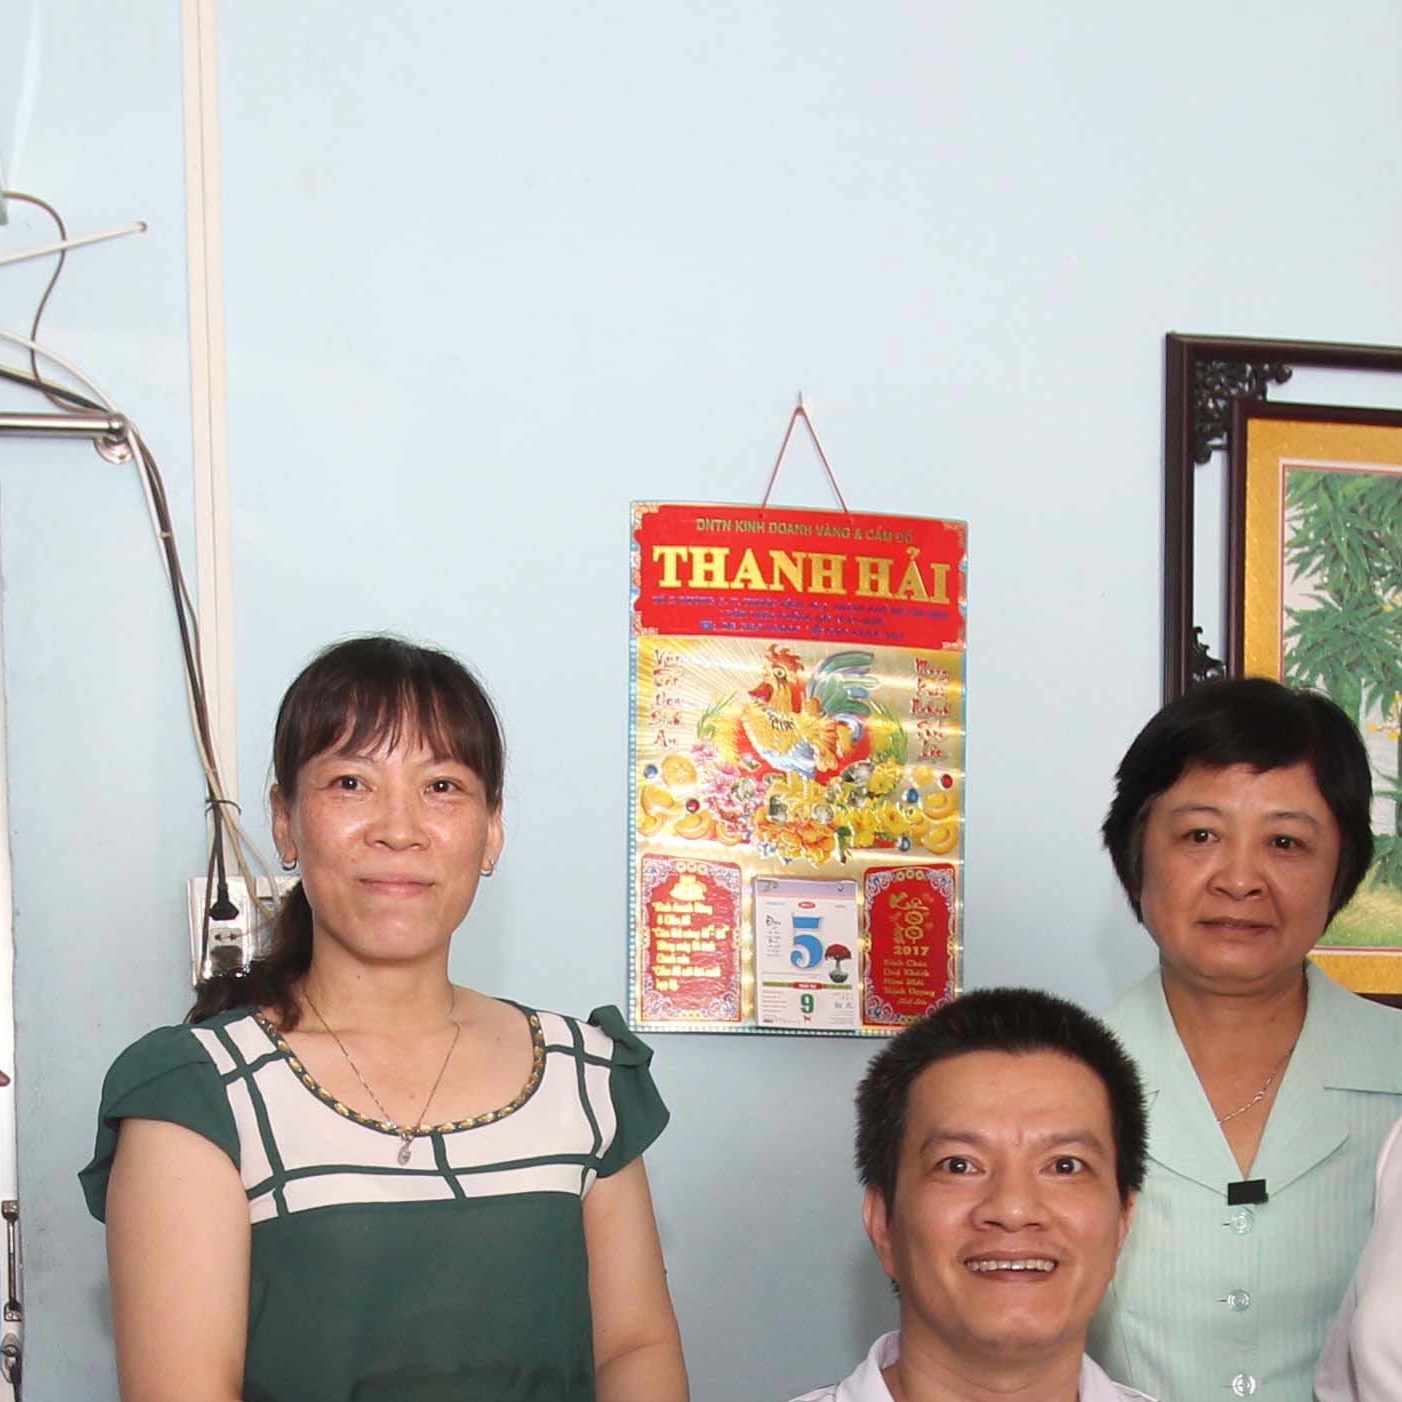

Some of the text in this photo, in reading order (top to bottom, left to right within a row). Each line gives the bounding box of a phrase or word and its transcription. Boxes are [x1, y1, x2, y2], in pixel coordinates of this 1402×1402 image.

[696, 518, 731, 531] DNTN
[735, 519, 765, 533] KINH
[768, 521, 811, 536] DOANH
[815, 522, 850, 539] VÀNG
[652, 544, 951, 605] THANH HẢI
[789, 915, 824, 970] 5
[893, 945, 930, 957] 2017
[800, 992, 815, 1015] 9
